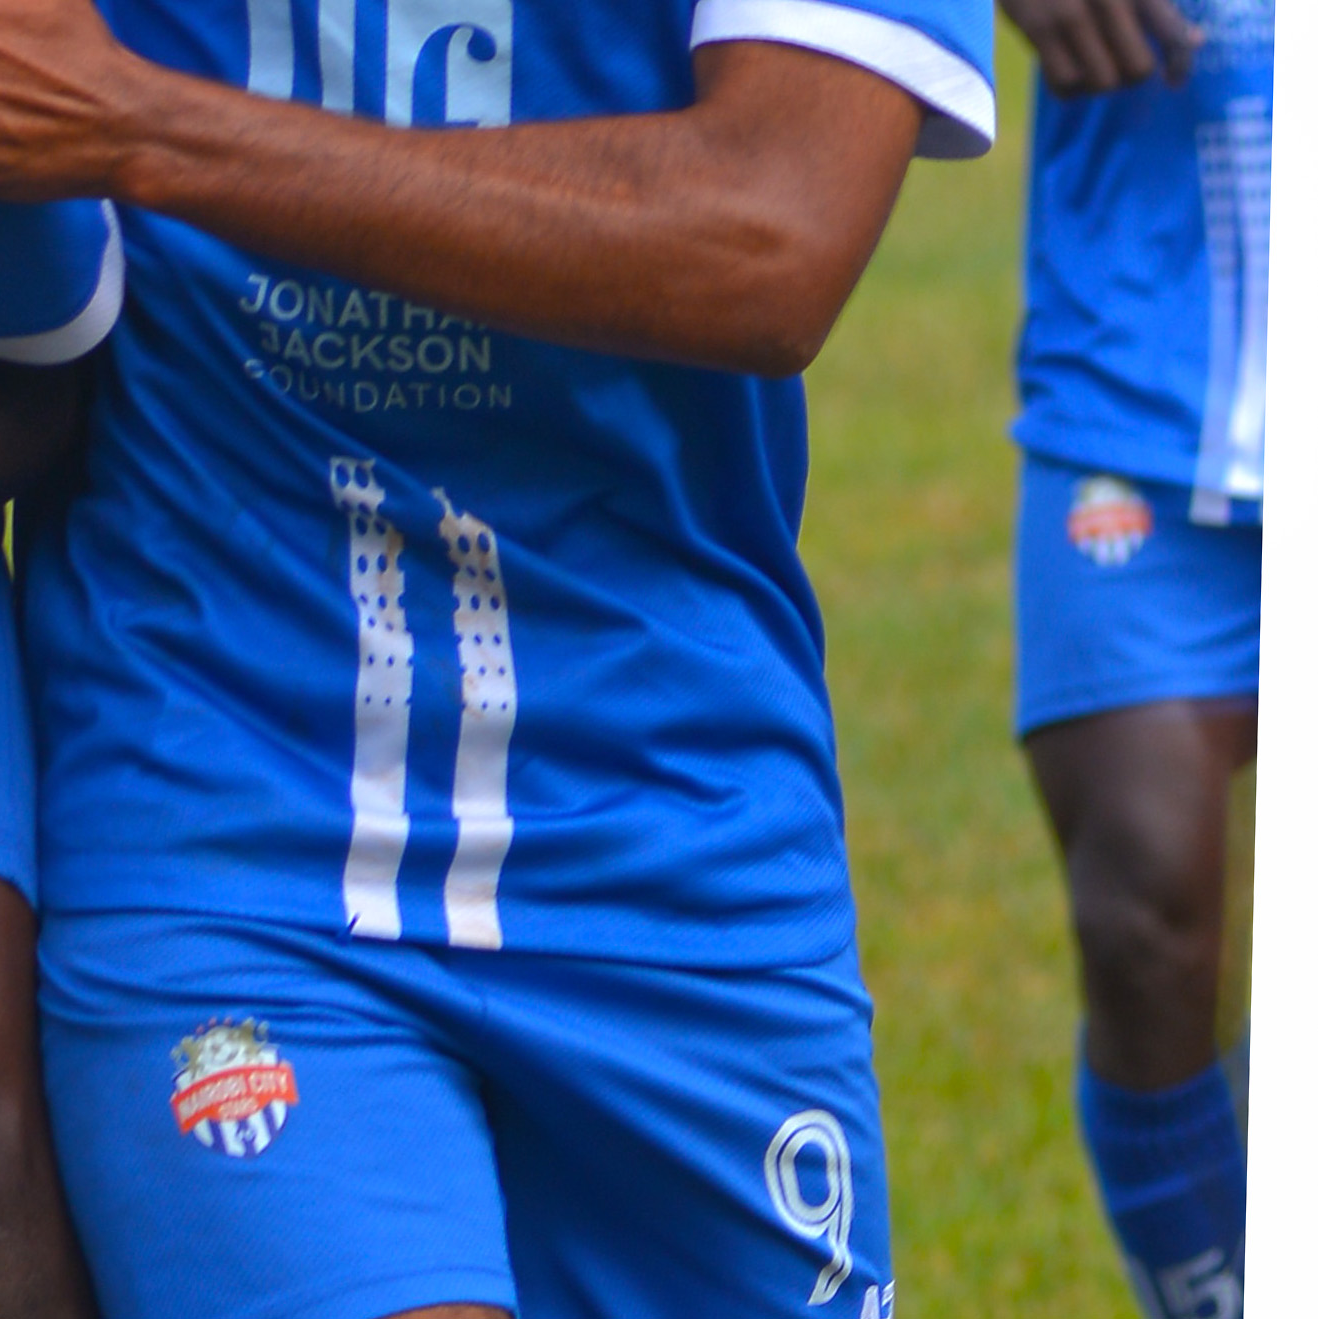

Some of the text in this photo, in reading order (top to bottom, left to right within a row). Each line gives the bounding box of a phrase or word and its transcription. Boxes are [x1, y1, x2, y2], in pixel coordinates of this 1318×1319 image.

[239, 273, 487, 331] JONATH
[260, 321, 491, 374] JACKSON
[765, 1108, 853, 1305] 9
